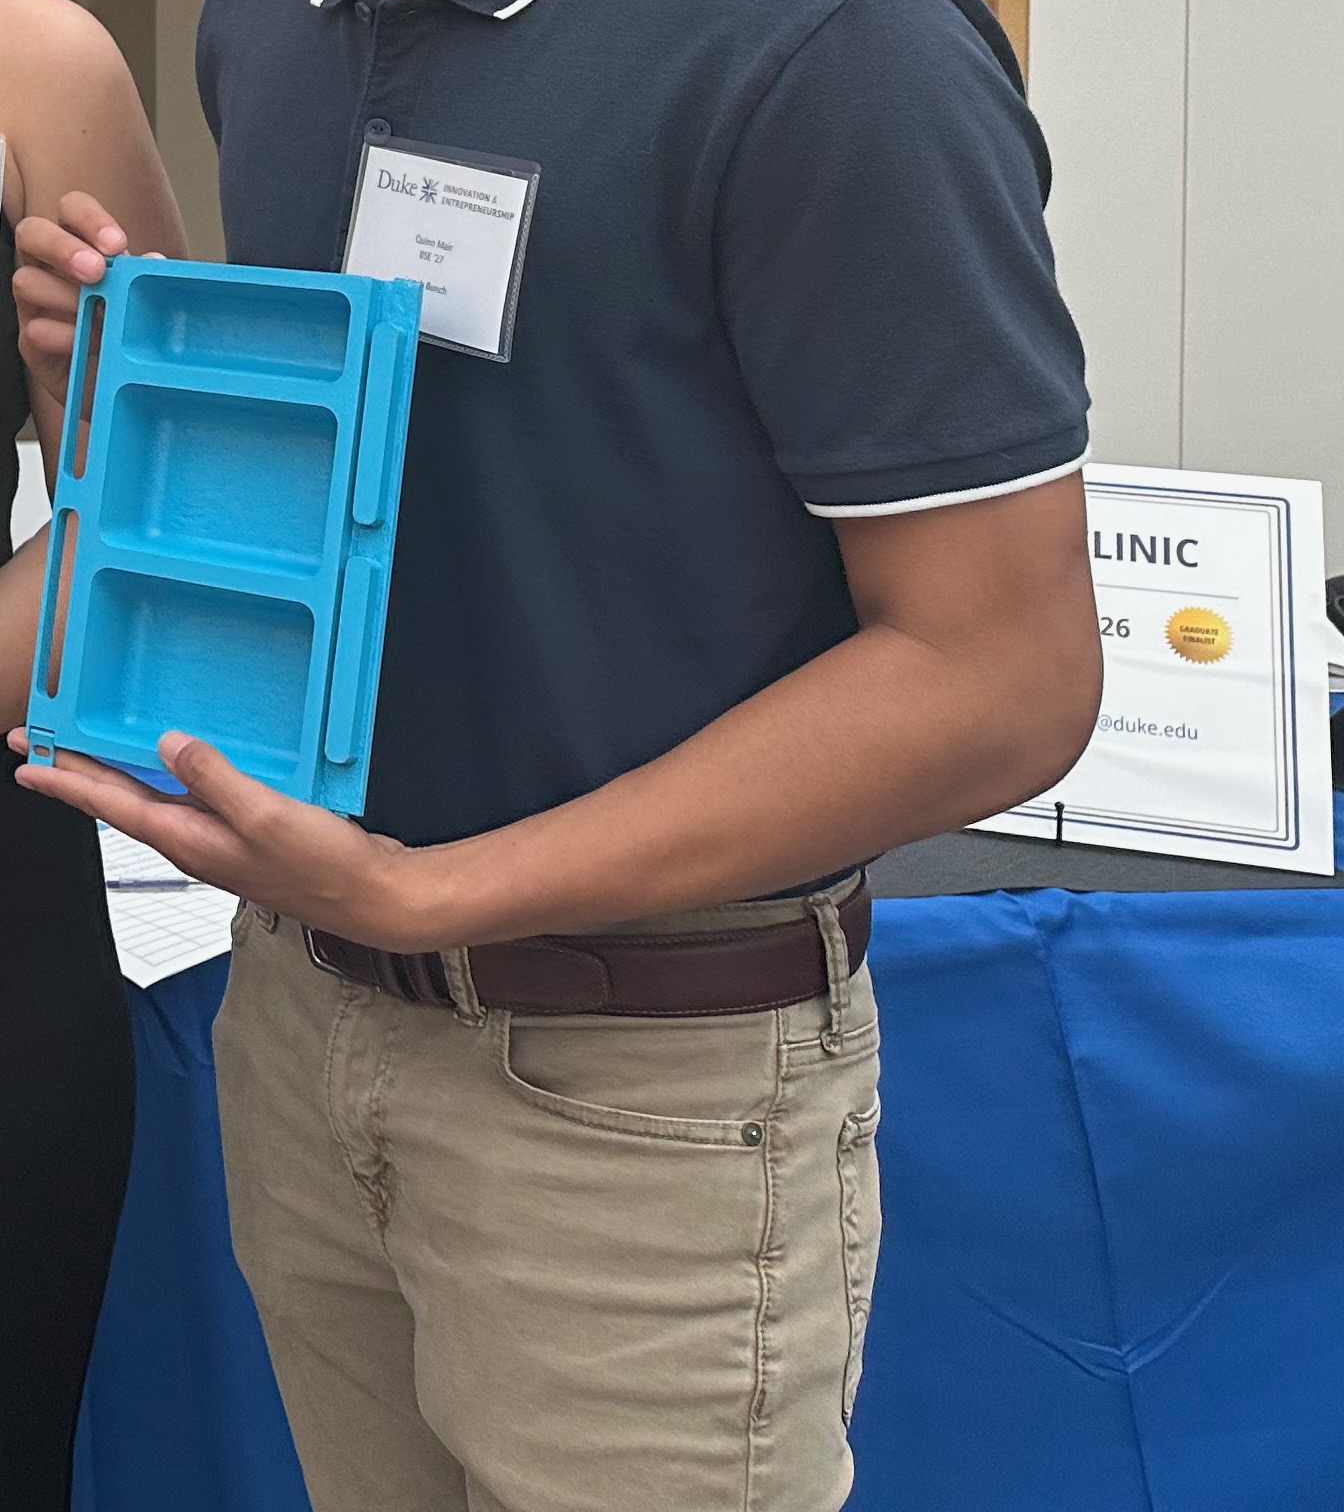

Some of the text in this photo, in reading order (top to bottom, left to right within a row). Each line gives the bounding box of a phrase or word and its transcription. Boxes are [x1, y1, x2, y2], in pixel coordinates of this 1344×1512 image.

[377, 169, 418, 197] Duke
[1094, 531, 1199, 568] LINIC
[1100, 616, 1131, 639] 26
[1097, 714, 1199, 741] @duke.edu
